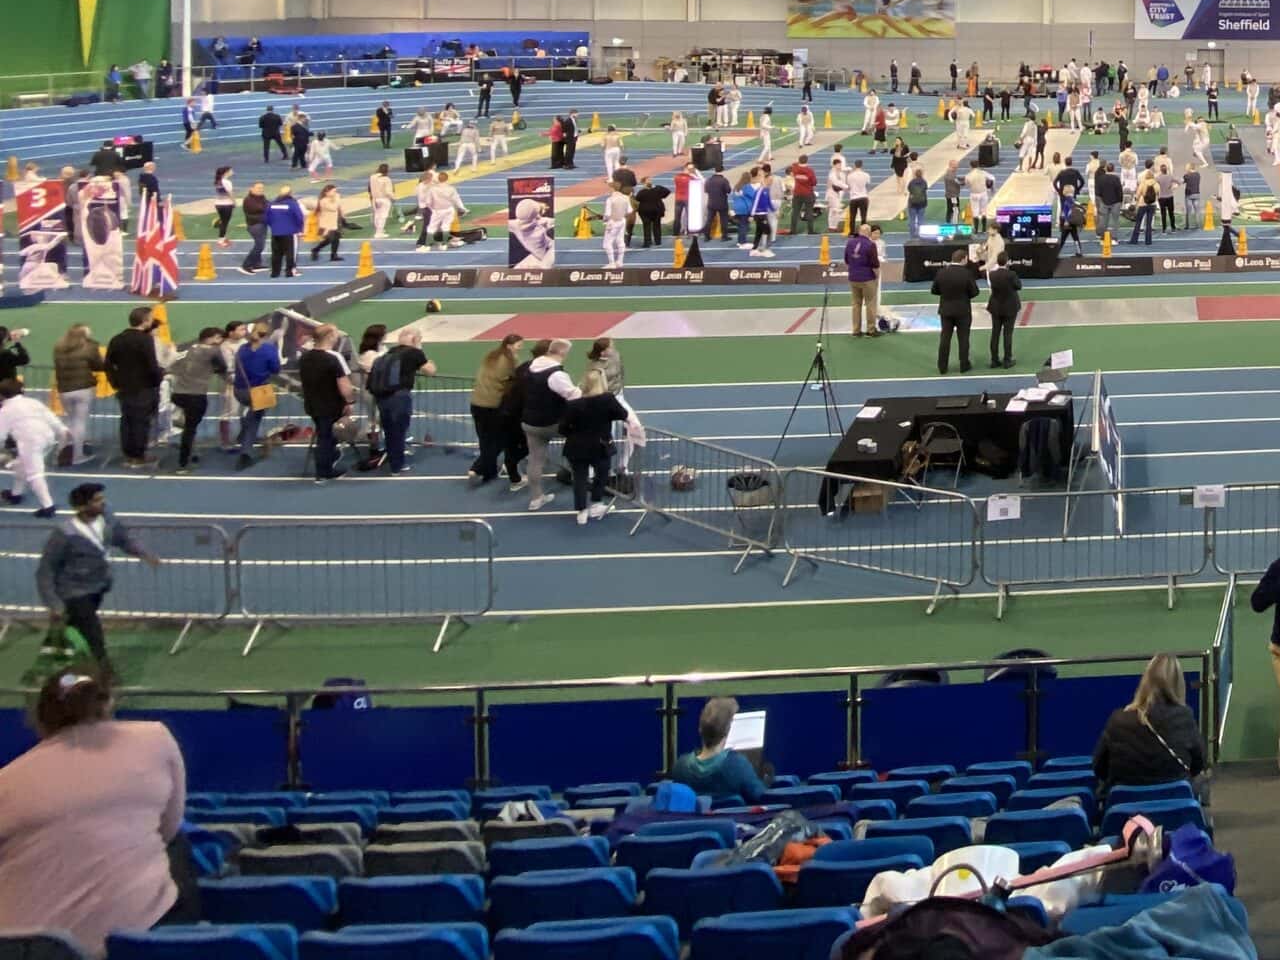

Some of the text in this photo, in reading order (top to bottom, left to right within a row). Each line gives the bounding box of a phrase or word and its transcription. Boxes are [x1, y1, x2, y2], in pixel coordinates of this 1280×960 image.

[1218, 19, 1270, 31] Sheffield
[30, 187, 48, 208] 3
[1244, 257, 1264, 266] Leon
[416, 272, 461, 282] Leon Paul
[524, 272, 543, 281] Paul
[580, 271, 624, 281] Leon Paul
[660, 270, 704, 280] Leon Paul
[740, 270, 782, 279] Leon Paul
